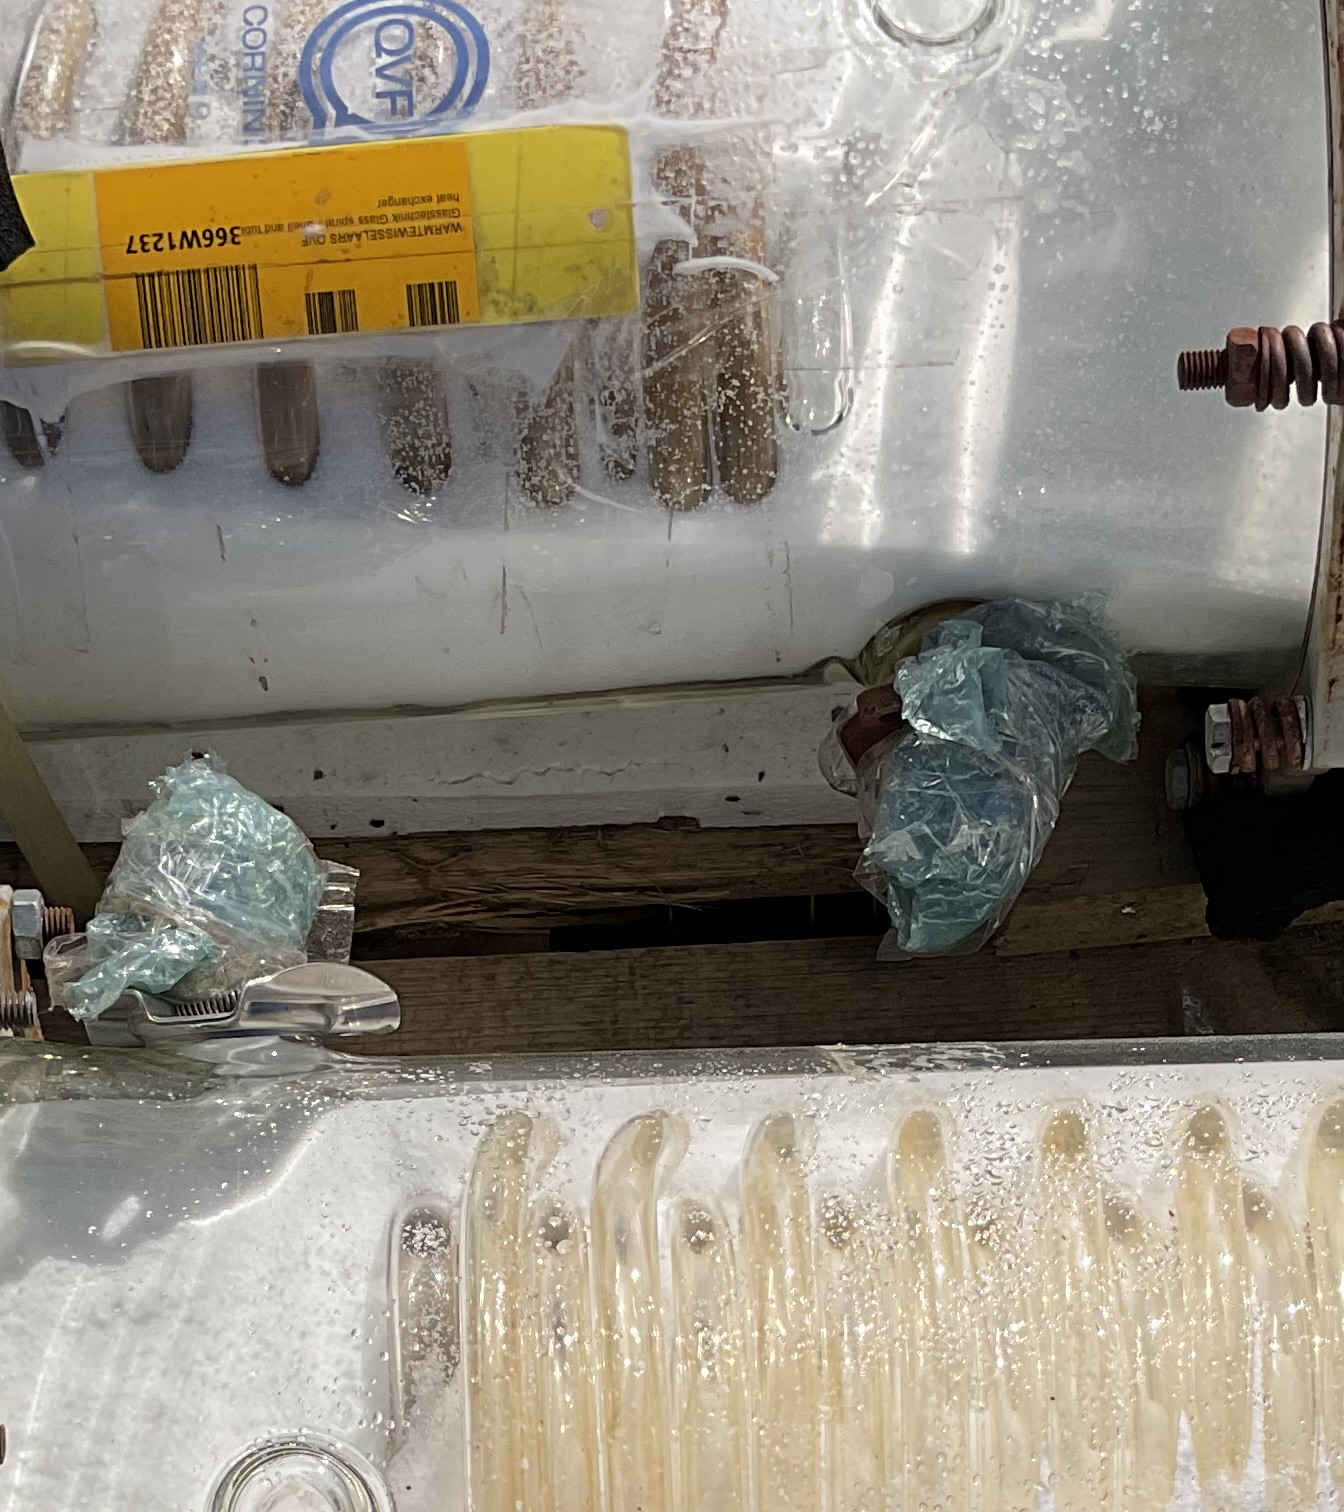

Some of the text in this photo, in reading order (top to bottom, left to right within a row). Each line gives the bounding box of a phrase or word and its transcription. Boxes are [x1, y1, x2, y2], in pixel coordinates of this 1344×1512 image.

[242, 5, 268, 145] CORNIN
[374, 18, 414, 117] QVF
[377, 192, 459, 210] heat exchanger
[358, 213, 388, 227] Glass
[392, 207, 461, 224] Glasstechnik
[265, 223, 284, 235] and
[330, 223, 462, 245] WARMTEWISSELAARS
[126, 226, 241, 254] 366W1237
